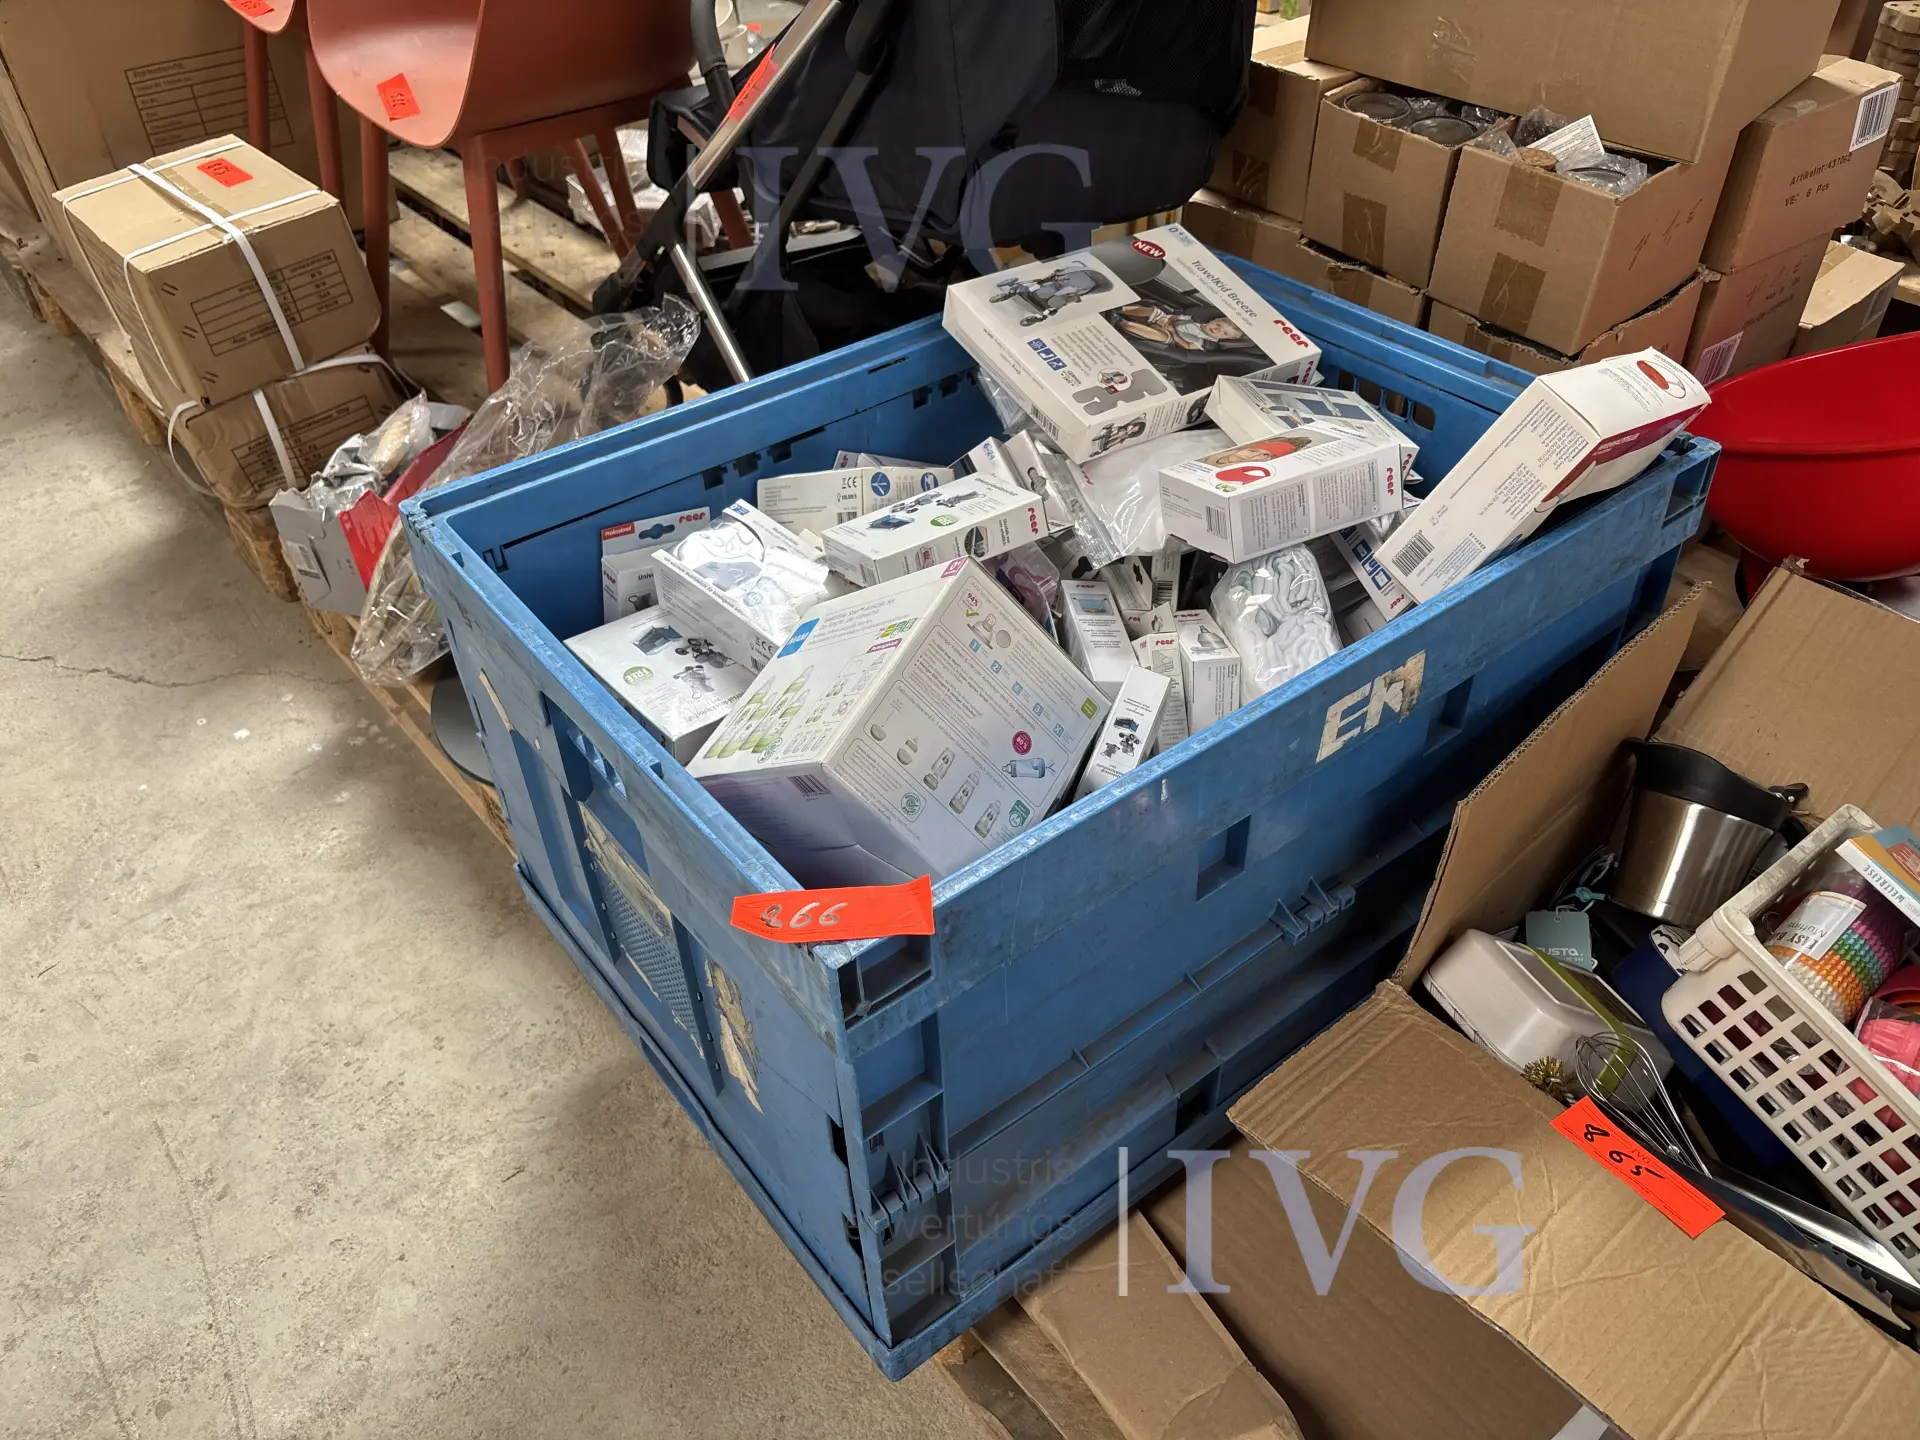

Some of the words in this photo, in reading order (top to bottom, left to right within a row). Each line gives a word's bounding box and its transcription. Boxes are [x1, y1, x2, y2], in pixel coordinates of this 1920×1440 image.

[1134, 240, 1164, 259] NEW
[1191, 260, 1232, 294] TravelKid
[1226, 291, 1258, 319] Breeze
[1273, 319, 1310, 349] reer
[1386, 467, 1395, 496] reer
[679, 511, 706, 524] reer
[1028, 507, 1039, 535] reer
[604, 525, 632, 537] Professional
[603, 570, 617, 585] reer
[1156, 638, 1175, 646] reer
[1862, 864, 1905, 903] WELTREISE
[1787, 921, 1828, 939] Muffins
[1788, 930, 1819, 951] EASY
[1583, 1123, 1667, 1181] 865
[1628, 1147, 1653, 1164] IVG
